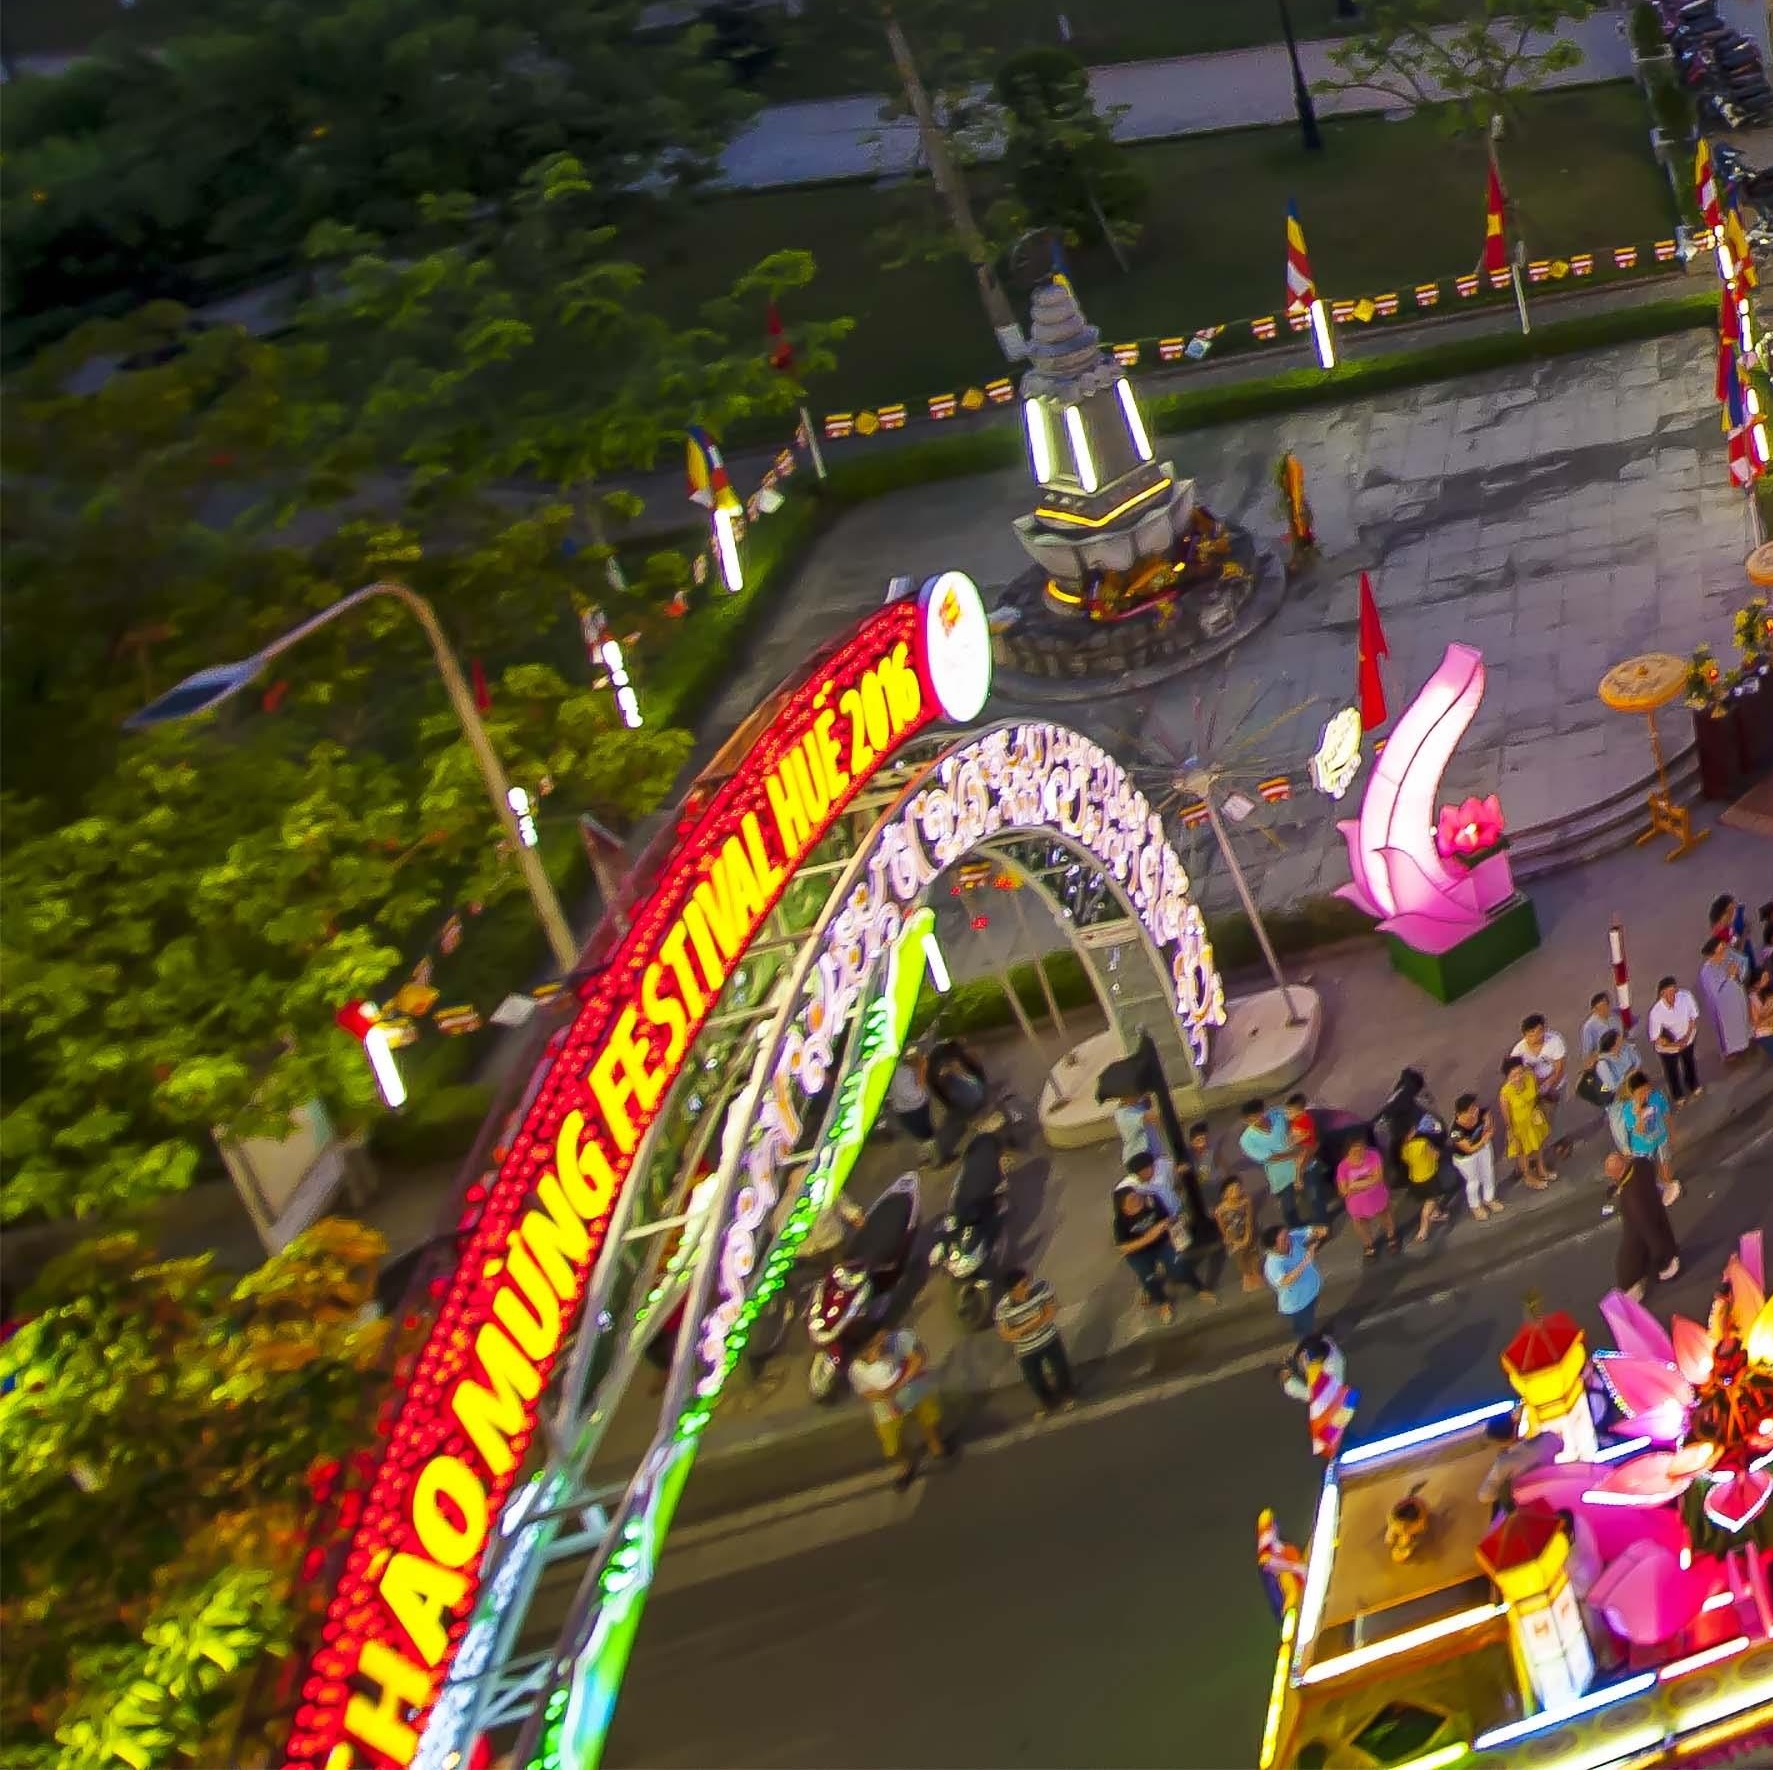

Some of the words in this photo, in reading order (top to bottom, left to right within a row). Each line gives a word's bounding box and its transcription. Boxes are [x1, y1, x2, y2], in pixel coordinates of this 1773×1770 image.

[327, 1456, 488, 1770] HÀO
[452, 1109, 616, 1477] MỪNG
[588, 810, 785, 1155] FESTIVAL
[765, 679, 850, 859] HUẾ
[840, 641, 921, 775] 2016
